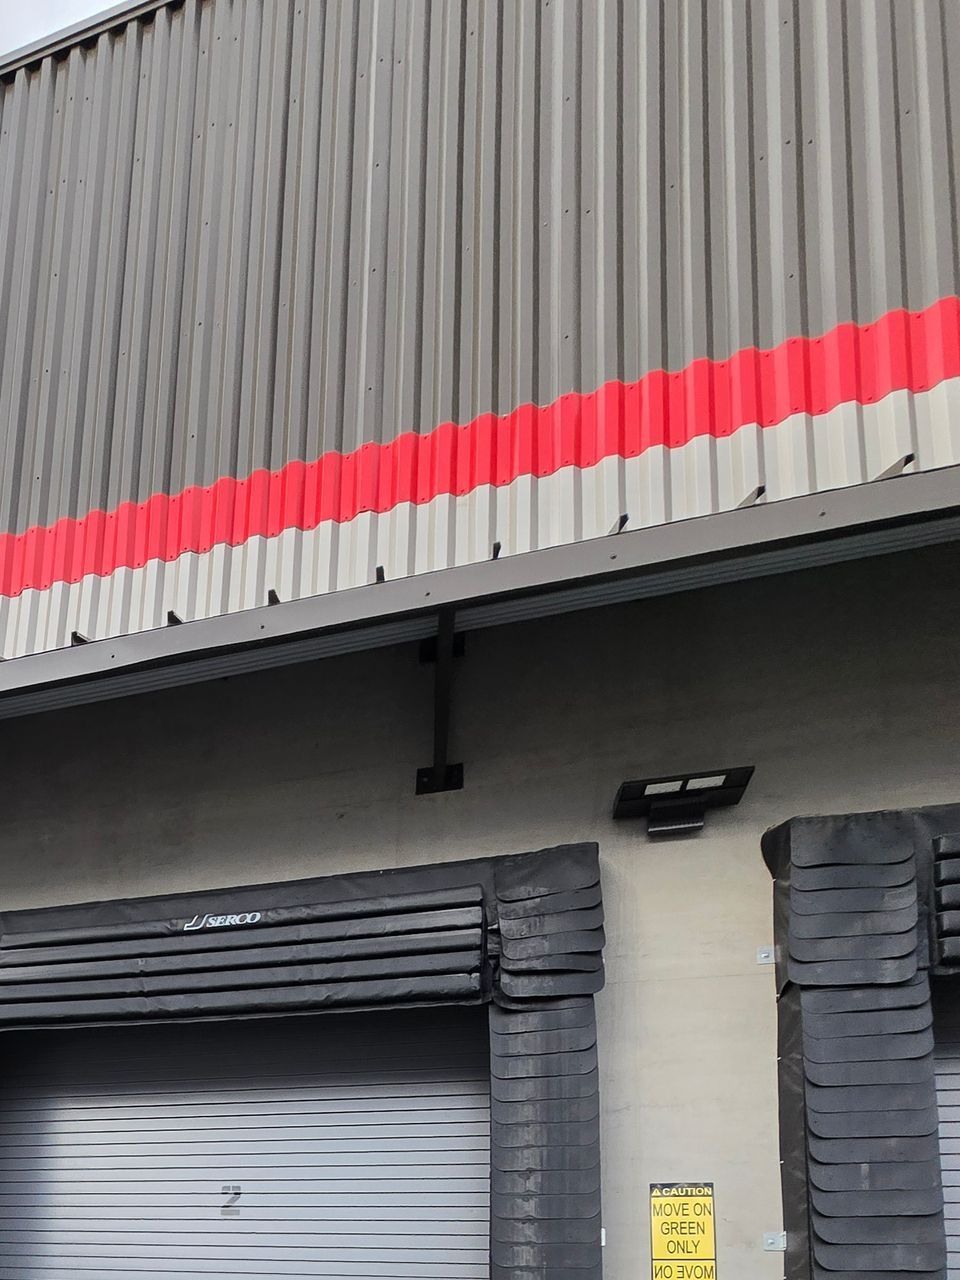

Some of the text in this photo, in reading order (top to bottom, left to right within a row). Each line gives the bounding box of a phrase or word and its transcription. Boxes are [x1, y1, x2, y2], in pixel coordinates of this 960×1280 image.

[206, 911, 261, 928] SERCO
[662, 1187, 712, 1196] CAUTION
[220, 1185, 241, 1216] 2
[653, 1202, 712, 1217] MOVE ON
[660, 1221, 705, 1235] GREEN
[666, 1240, 700, 1254] ONLY
